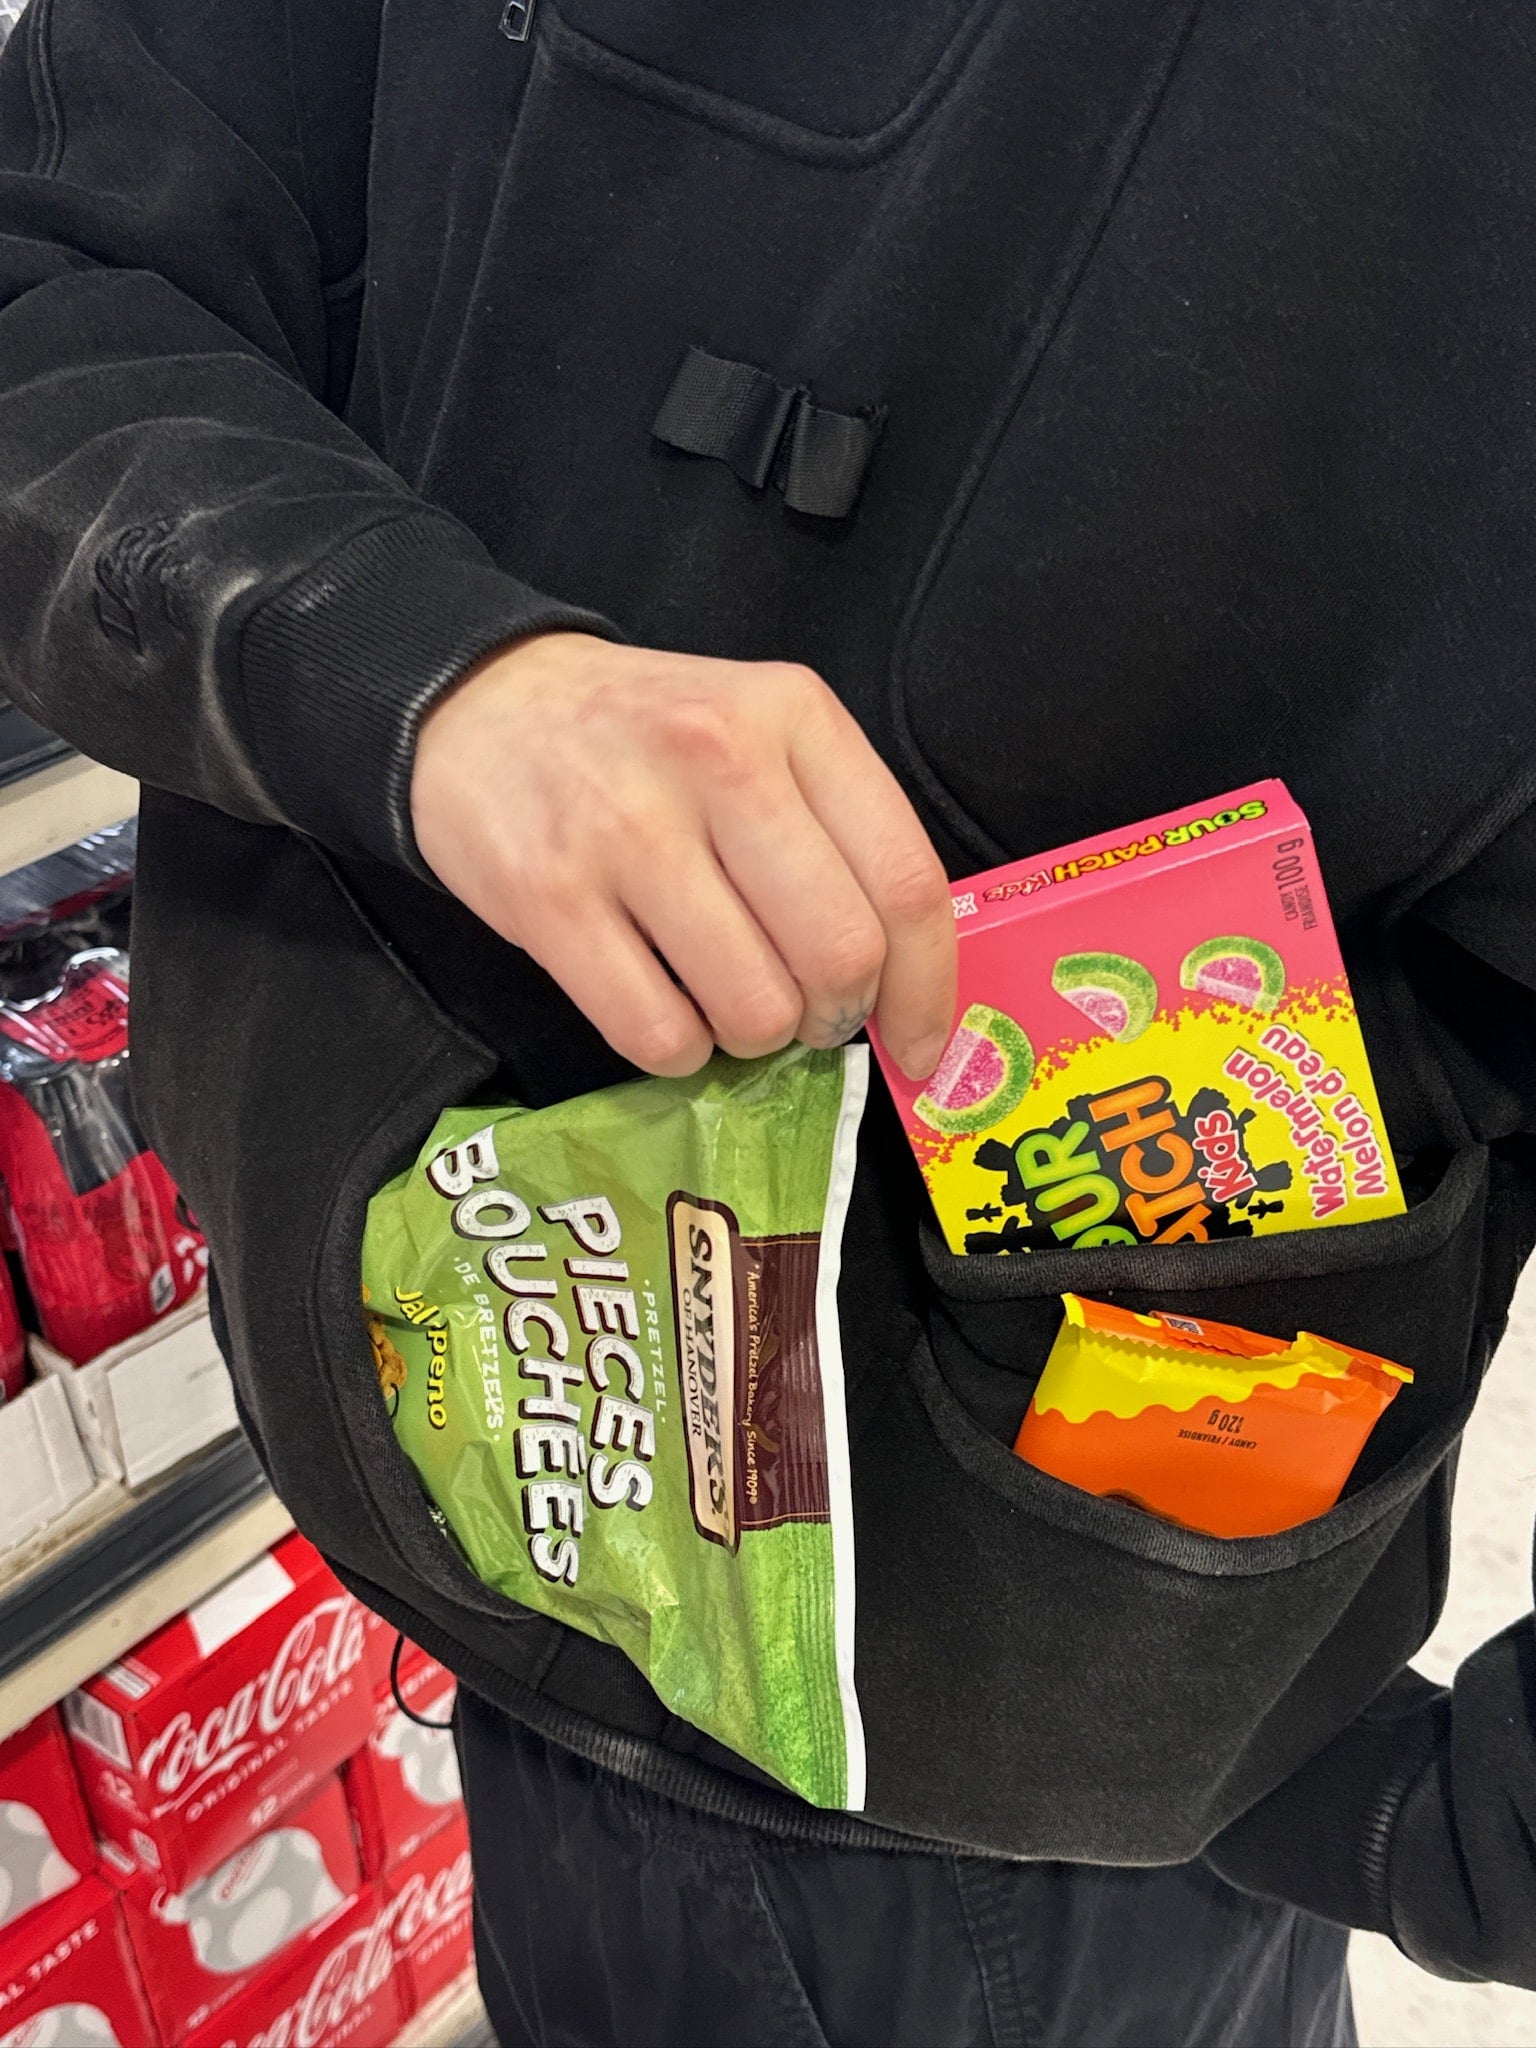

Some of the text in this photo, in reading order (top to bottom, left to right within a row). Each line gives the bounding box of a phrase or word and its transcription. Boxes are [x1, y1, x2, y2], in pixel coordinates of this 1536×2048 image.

[983, 800, 1268, 902] SOUR PATCH Kids
[1272, 838, 1305, 891] 100 g
[1193, 1109, 1258, 1203] Kids
[1224, 1049, 1348, 1219] Watermelon
[1261, 1025, 1387, 1197] Melon d'eau
[1014, 1120, 1137, 1250] UR
[1087, 1080, 1208, 1246] ATCH
[454, 1261, 505, 1430] DE BRETZELS
[746, 1270, 761, 1332] America's
[394, 1286, 448, 1430] Jalpeno
[425, 1124, 586, 1589] BOUCHÉES
[537, 1195, 657, 1512] PIECES
[683, 1287, 702, 1437] OF HANOVER
[747, 1334, 762, 1379] Pretzel
[740, 1381, 759, 1427] Bakery
[746, 1430, 758, 1466] Since
[1177, 1428, 1222, 1445] FRIANDISE
[1207, 1408, 1245, 1434] 120 g
[1228, 1439, 1257, 1450] CANDY
[26, 1918, 100, 1983] TASTE
